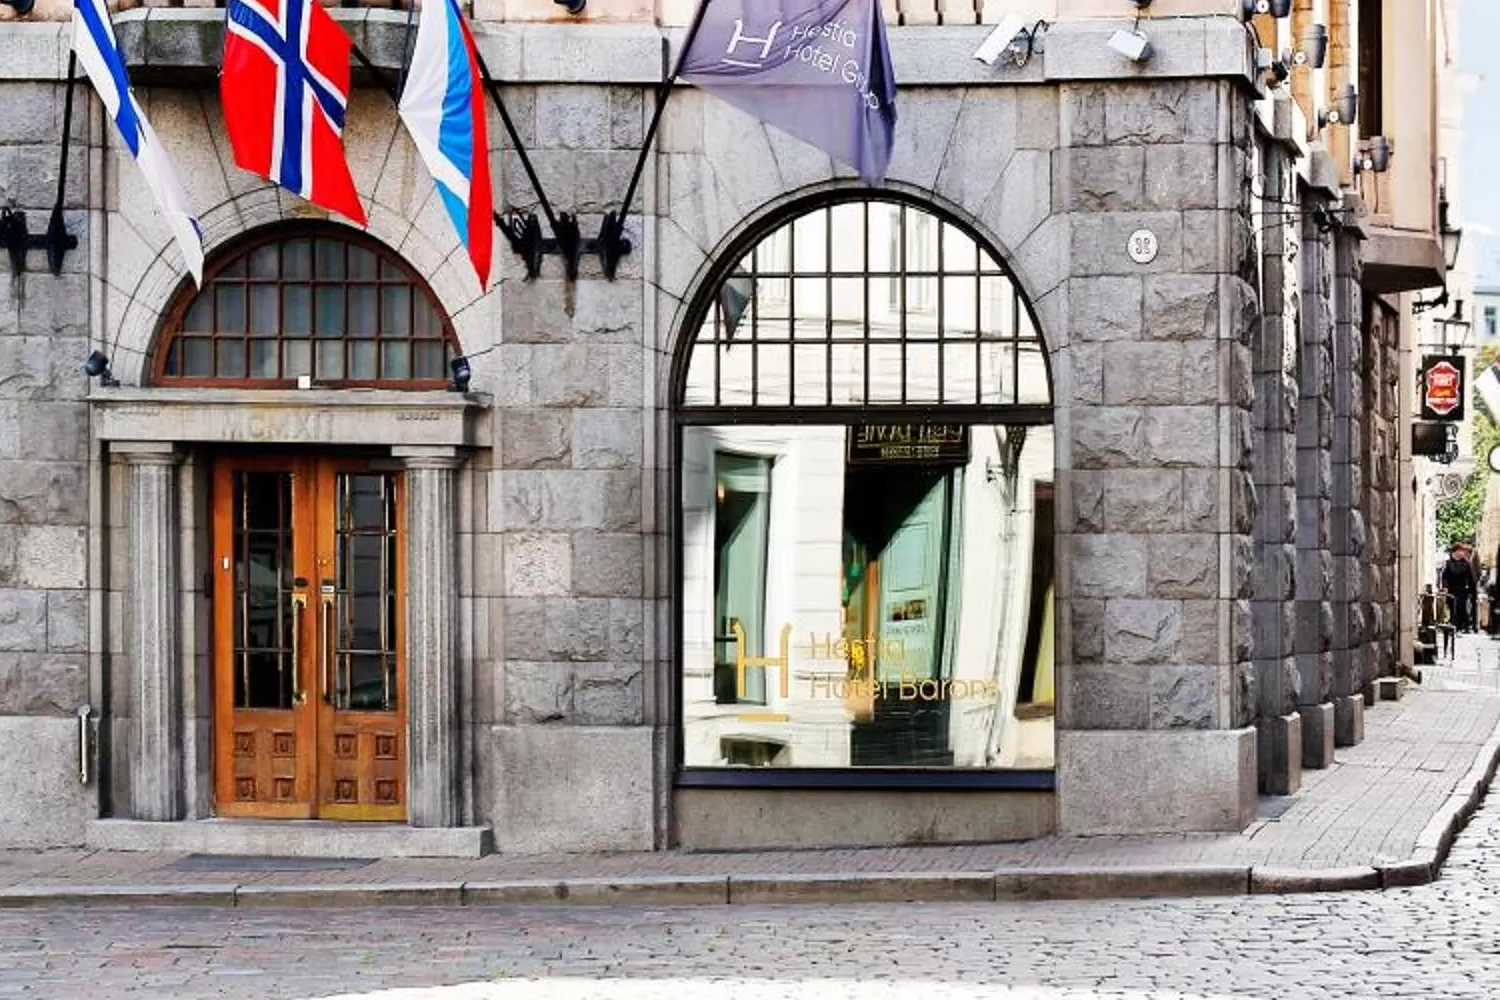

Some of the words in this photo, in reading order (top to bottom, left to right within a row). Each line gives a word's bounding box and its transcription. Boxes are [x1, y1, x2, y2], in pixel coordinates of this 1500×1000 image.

[726, 19, 783, 59] H
[789, 19, 858, 47] Hestia
[784, 46, 840, 73] Hotel
[732, 618, 793, 699] H
[810, 631, 906, 662] Hestia
[810, 671, 889, 701] Hotel
[898, 674, 1002, 702] Barons
